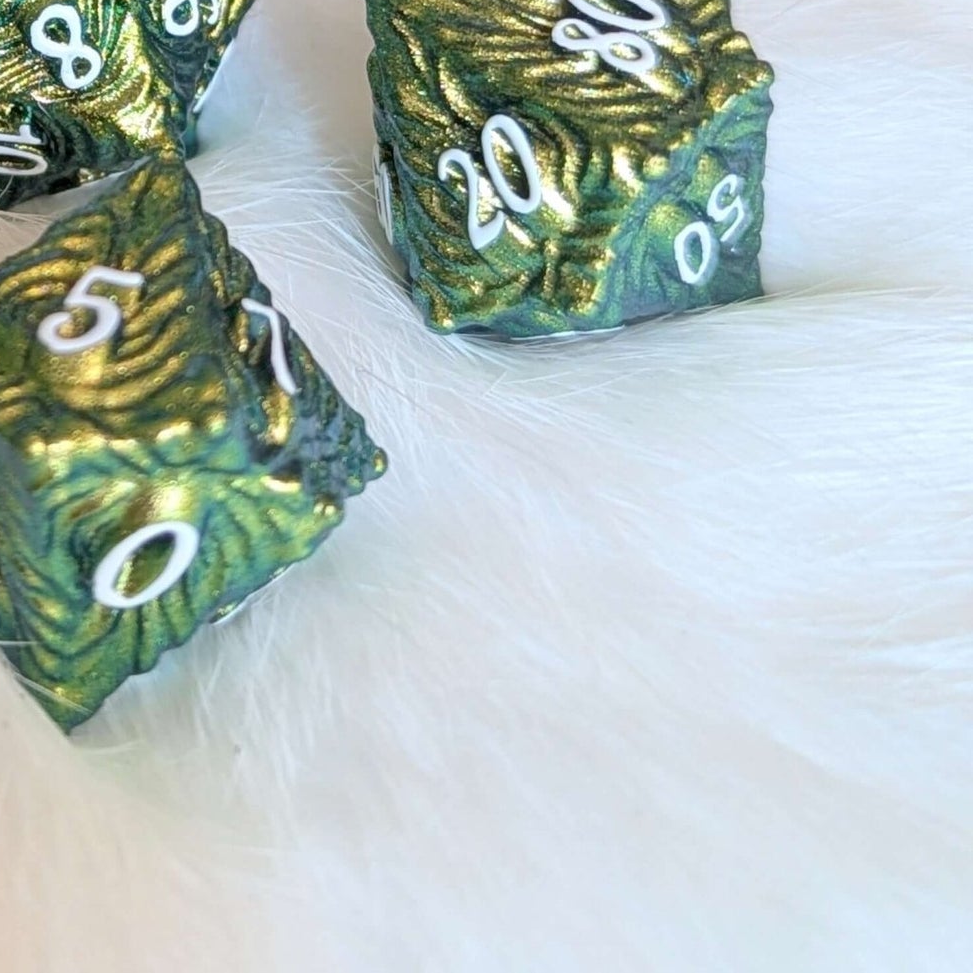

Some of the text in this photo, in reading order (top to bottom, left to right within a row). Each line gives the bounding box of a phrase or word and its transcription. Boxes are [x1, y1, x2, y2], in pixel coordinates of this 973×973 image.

[29, 3, 103, 90] 8
[438, 113, 544, 252] 20
[673, 173, 752, 286] 50
[37, 265, 146, 355] 5
[241, 297, 298, 395] 7
[93, 520, 201, 609] 0
